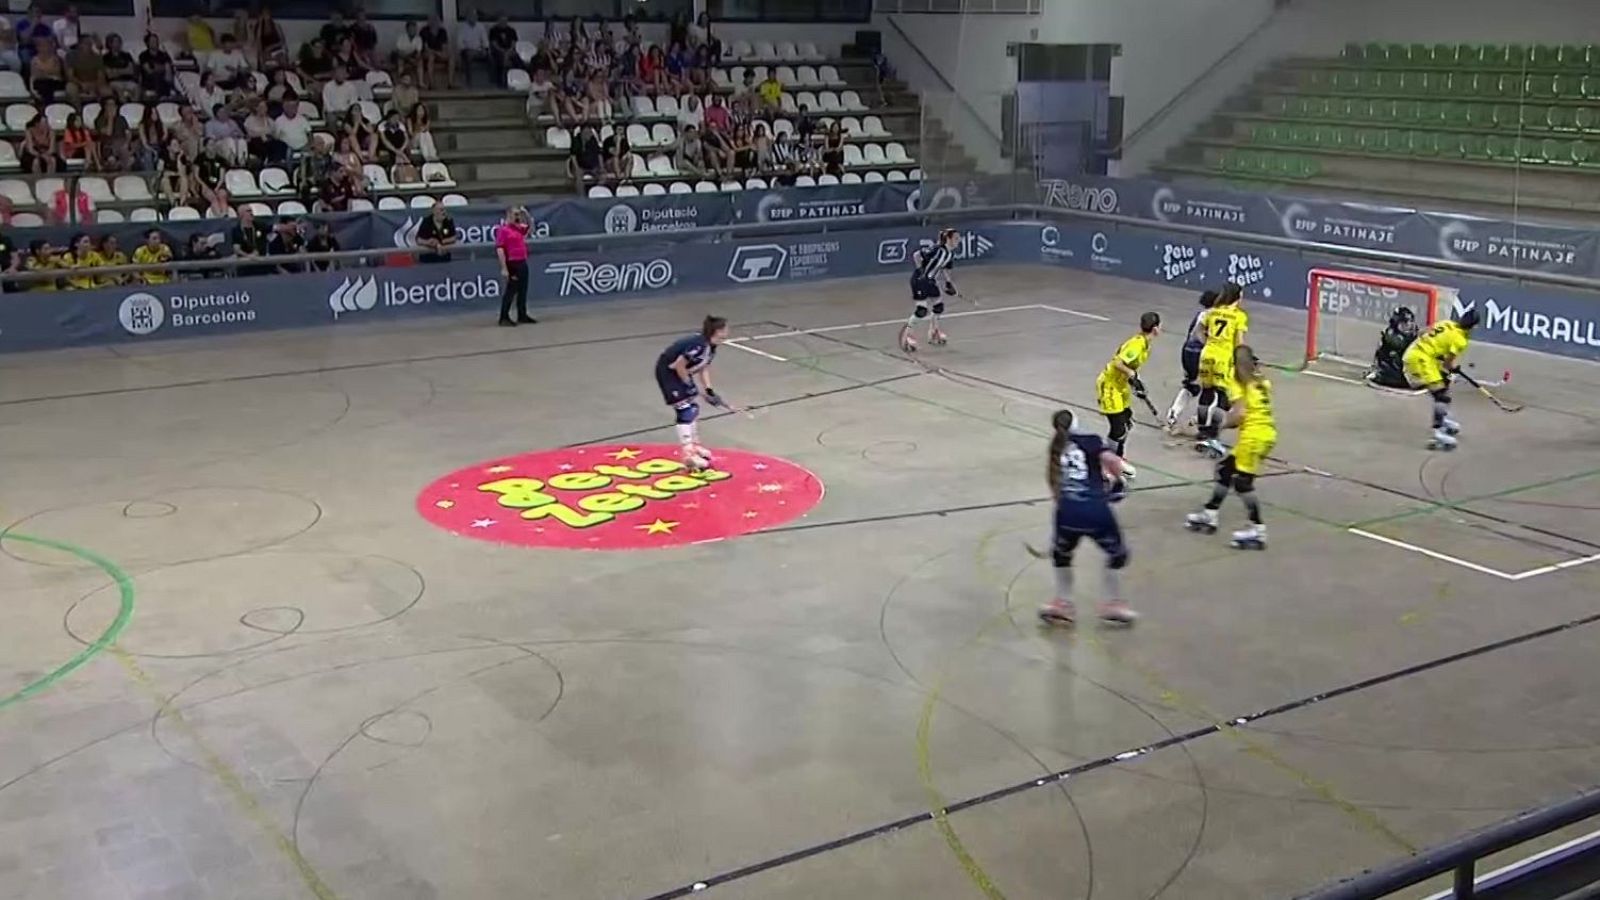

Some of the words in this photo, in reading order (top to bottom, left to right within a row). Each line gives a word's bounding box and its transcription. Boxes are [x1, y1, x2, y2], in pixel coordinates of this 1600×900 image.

[1039, 179, 1117, 213] Reno
[642, 206, 698, 221] Diputació
[799, 205, 865, 217] PATINAJE
[1187, 205, 1246, 223] PATINAJE
[1323, 223, 1394, 243] PATINAJE
[1487, 243, 1576, 264] PATINAJE
[545, 258, 673, 297] Reno
[171, 291, 250, 309] Diputació
[383, 274, 499, 306] Iberdrola
[172, 309, 256, 328] Barcelona
[1214, 319, 1228, 337] 7
[477, 457, 688, 508] Peta
[519, 467, 733, 528] Zetas
